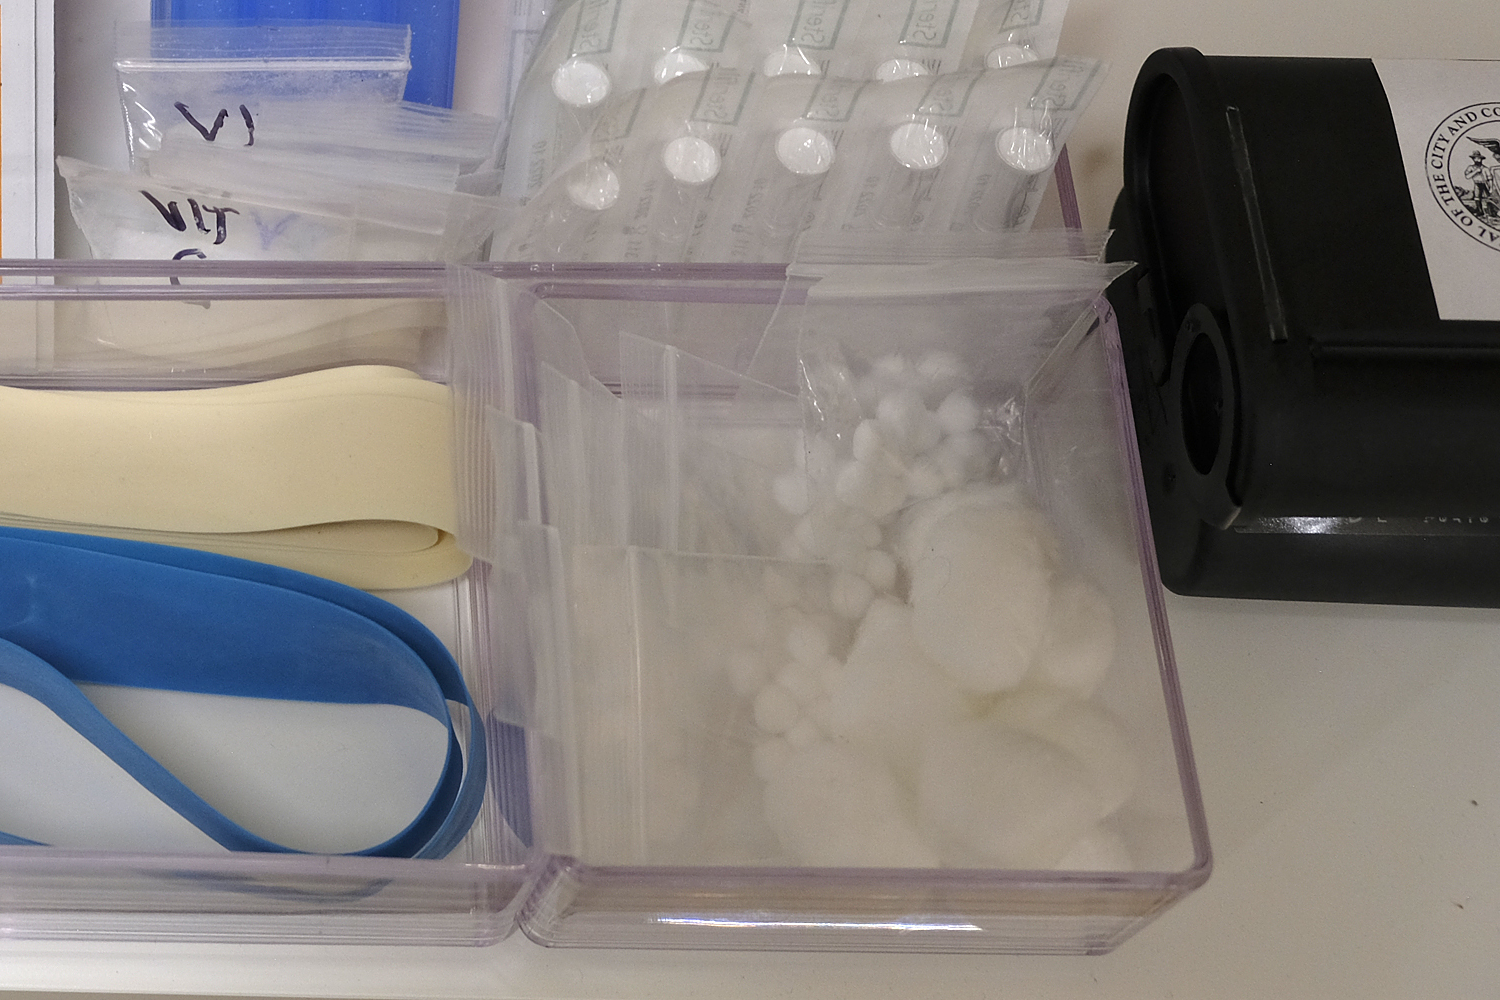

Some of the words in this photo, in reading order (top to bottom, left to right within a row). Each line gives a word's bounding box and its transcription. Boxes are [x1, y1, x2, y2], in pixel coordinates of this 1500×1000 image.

[1447, 111, 1478, 136] AND
[1431, 133, 1450, 170] CITY
[1433, 173, 1455, 206] THE
[1451, 208, 1473, 227] OF
